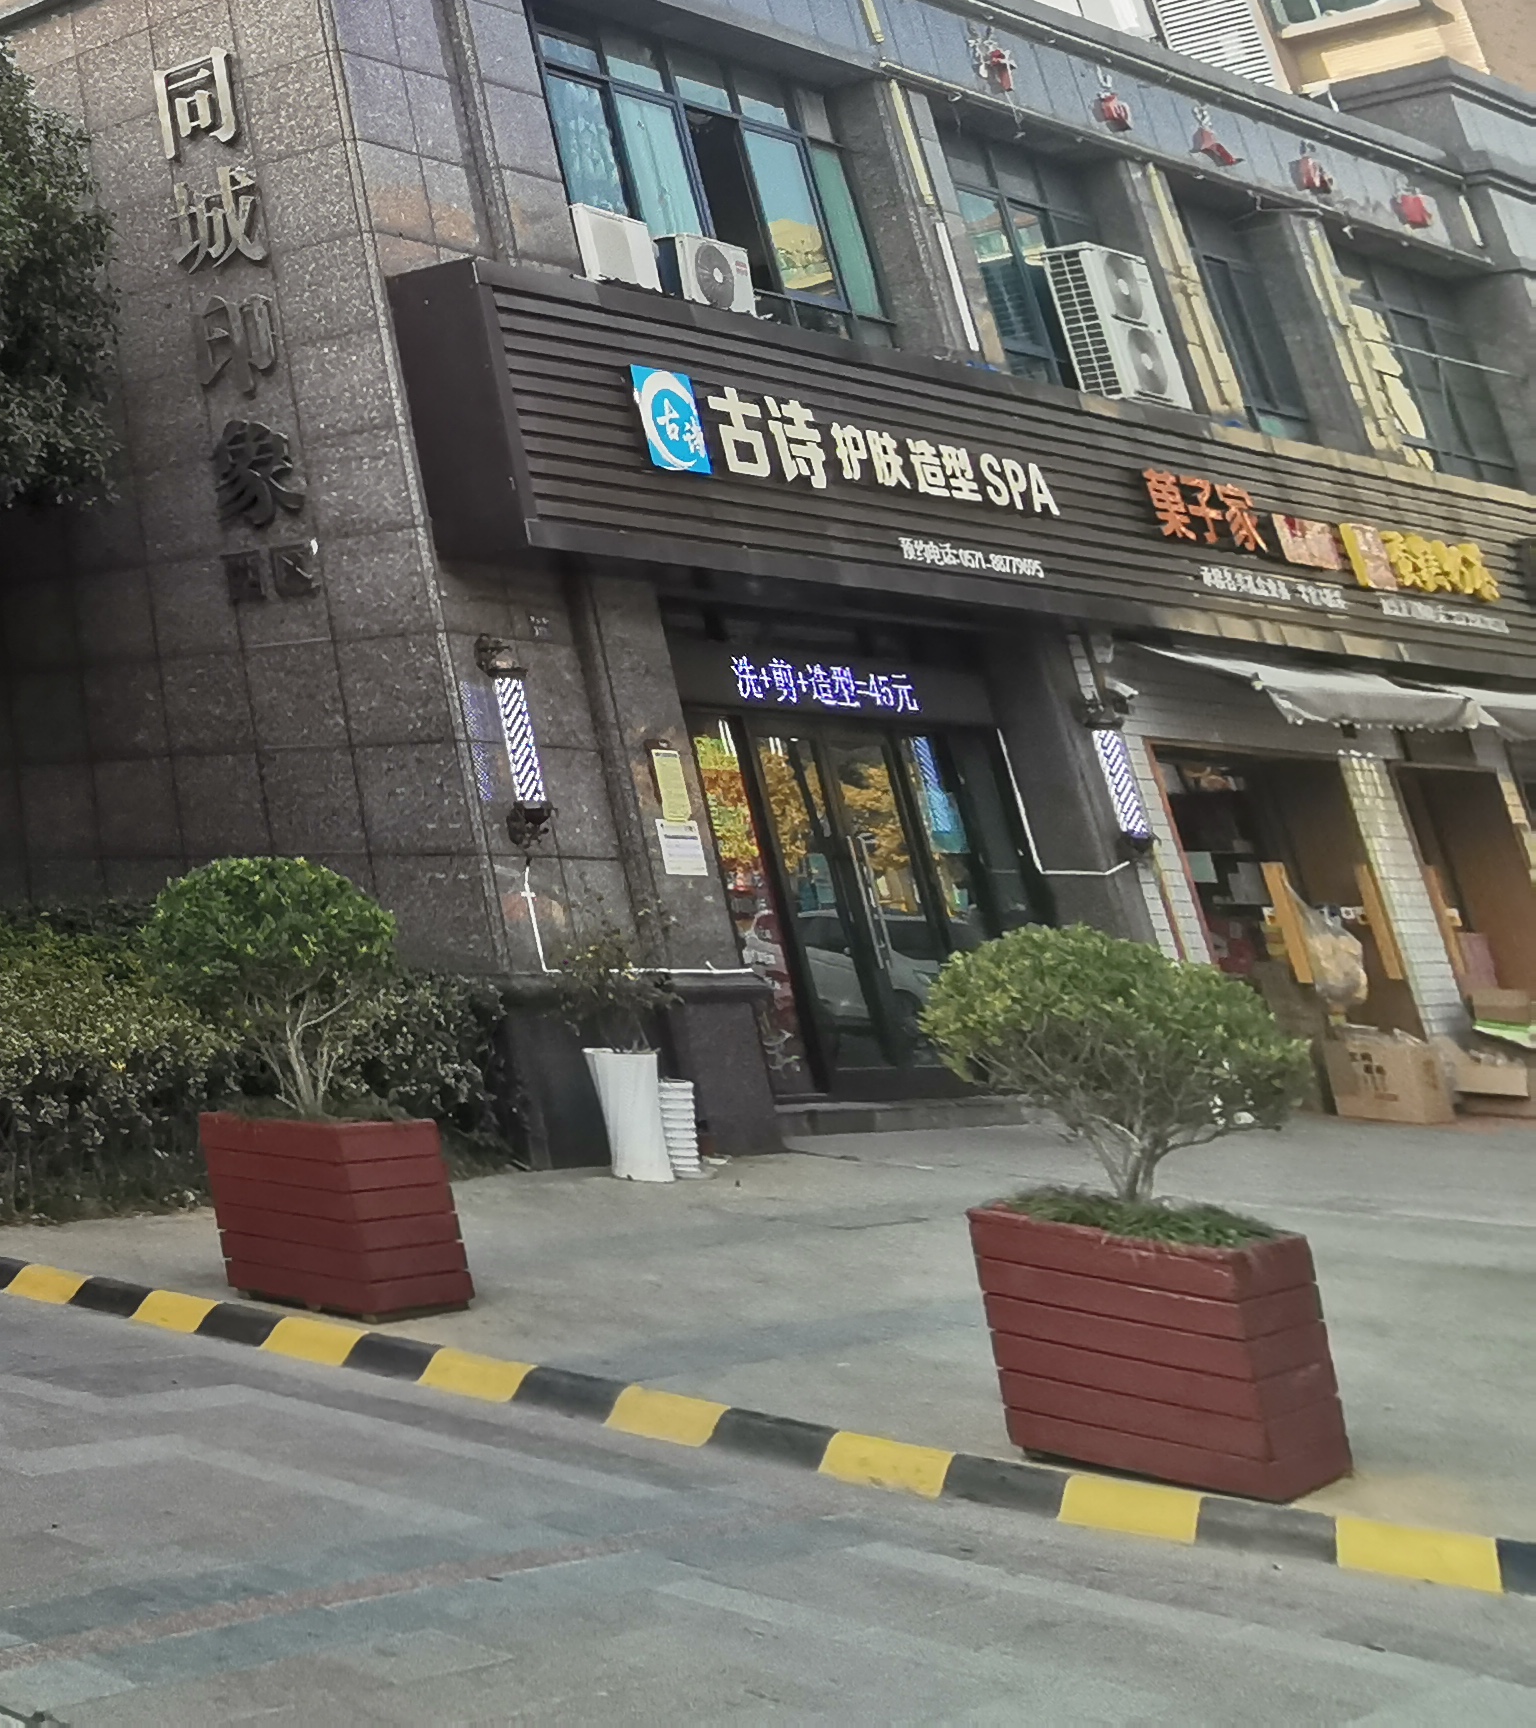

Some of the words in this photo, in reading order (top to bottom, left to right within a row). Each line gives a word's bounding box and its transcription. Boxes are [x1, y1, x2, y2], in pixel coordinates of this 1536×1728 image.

[657, 399, 706, 460] 古诗
[707, 387, 826, 489] 古诗
[980, 453, 1061, 517] SPA
[730, 655, 919, 713] 洗+剪+造型=45元
